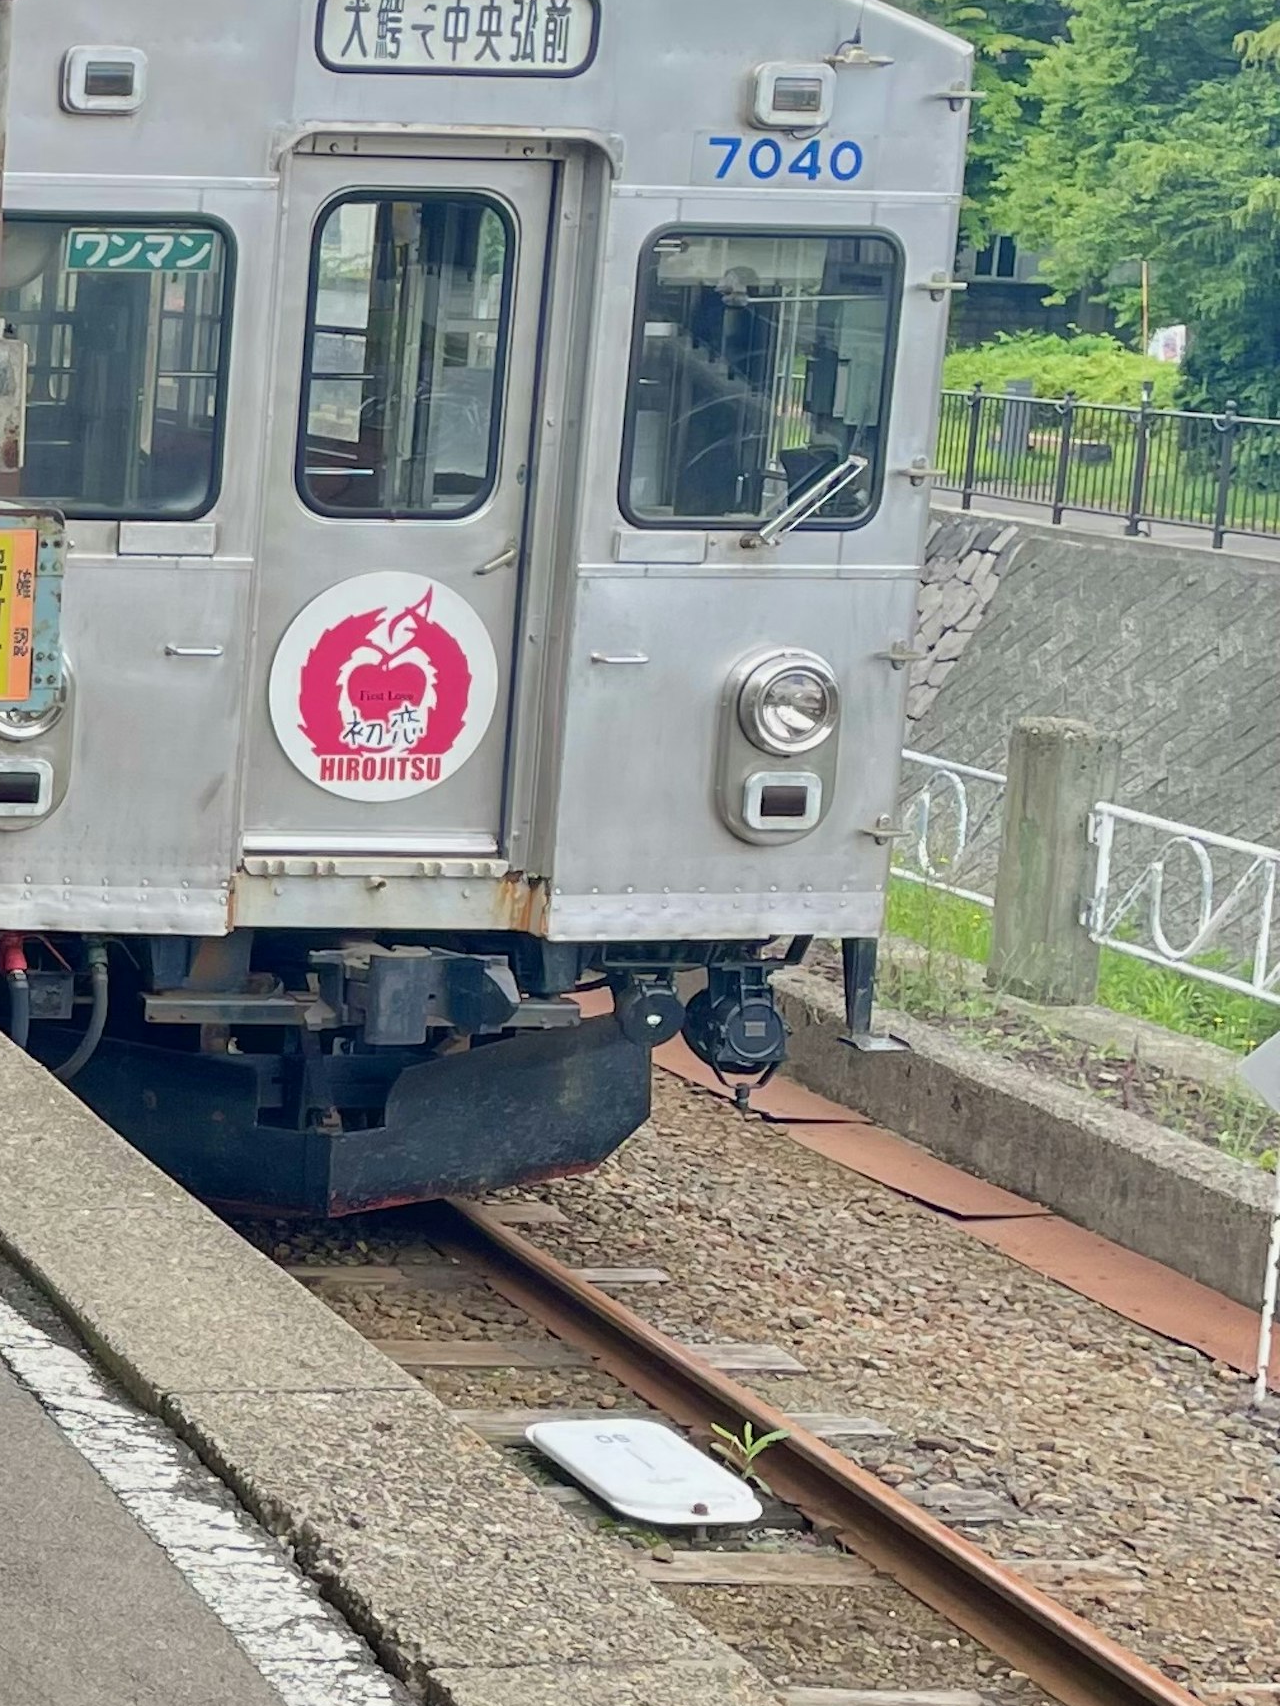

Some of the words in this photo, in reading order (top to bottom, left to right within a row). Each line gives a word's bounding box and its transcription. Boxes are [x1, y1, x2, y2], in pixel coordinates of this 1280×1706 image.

[708, 137, 863, 182] 7040
[74, 233, 212, 268] ワンマン
[342, 704, 424, 745] 初恋
[319, 756, 441, 782] HIROJITSU
